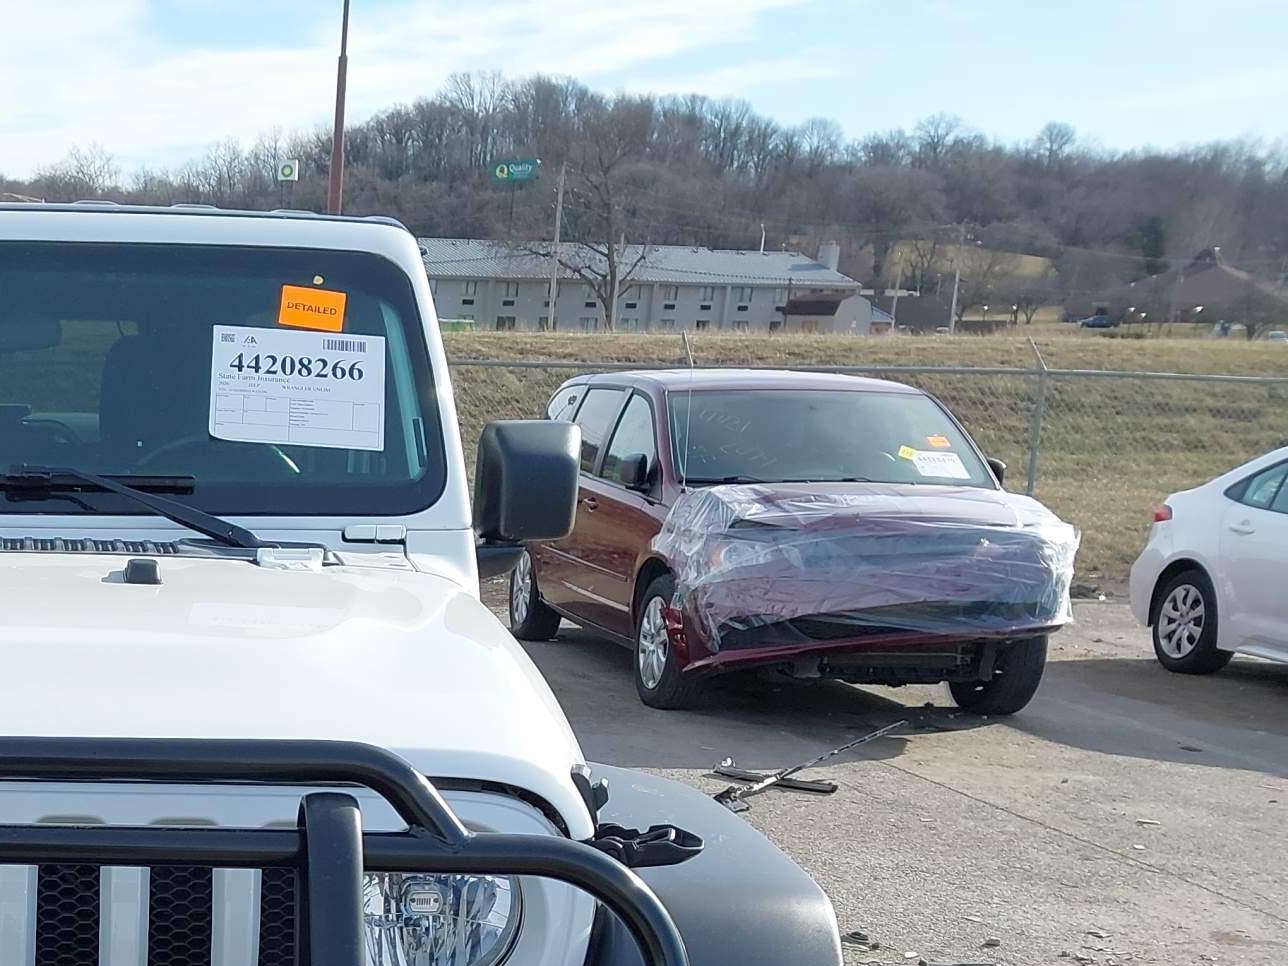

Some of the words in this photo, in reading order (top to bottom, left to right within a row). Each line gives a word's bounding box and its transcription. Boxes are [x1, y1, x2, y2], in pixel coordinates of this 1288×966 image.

[287, 302, 337, 316] DETAILED
[229, 352, 365, 381] 44208266
[218, 372, 236, 380] State
